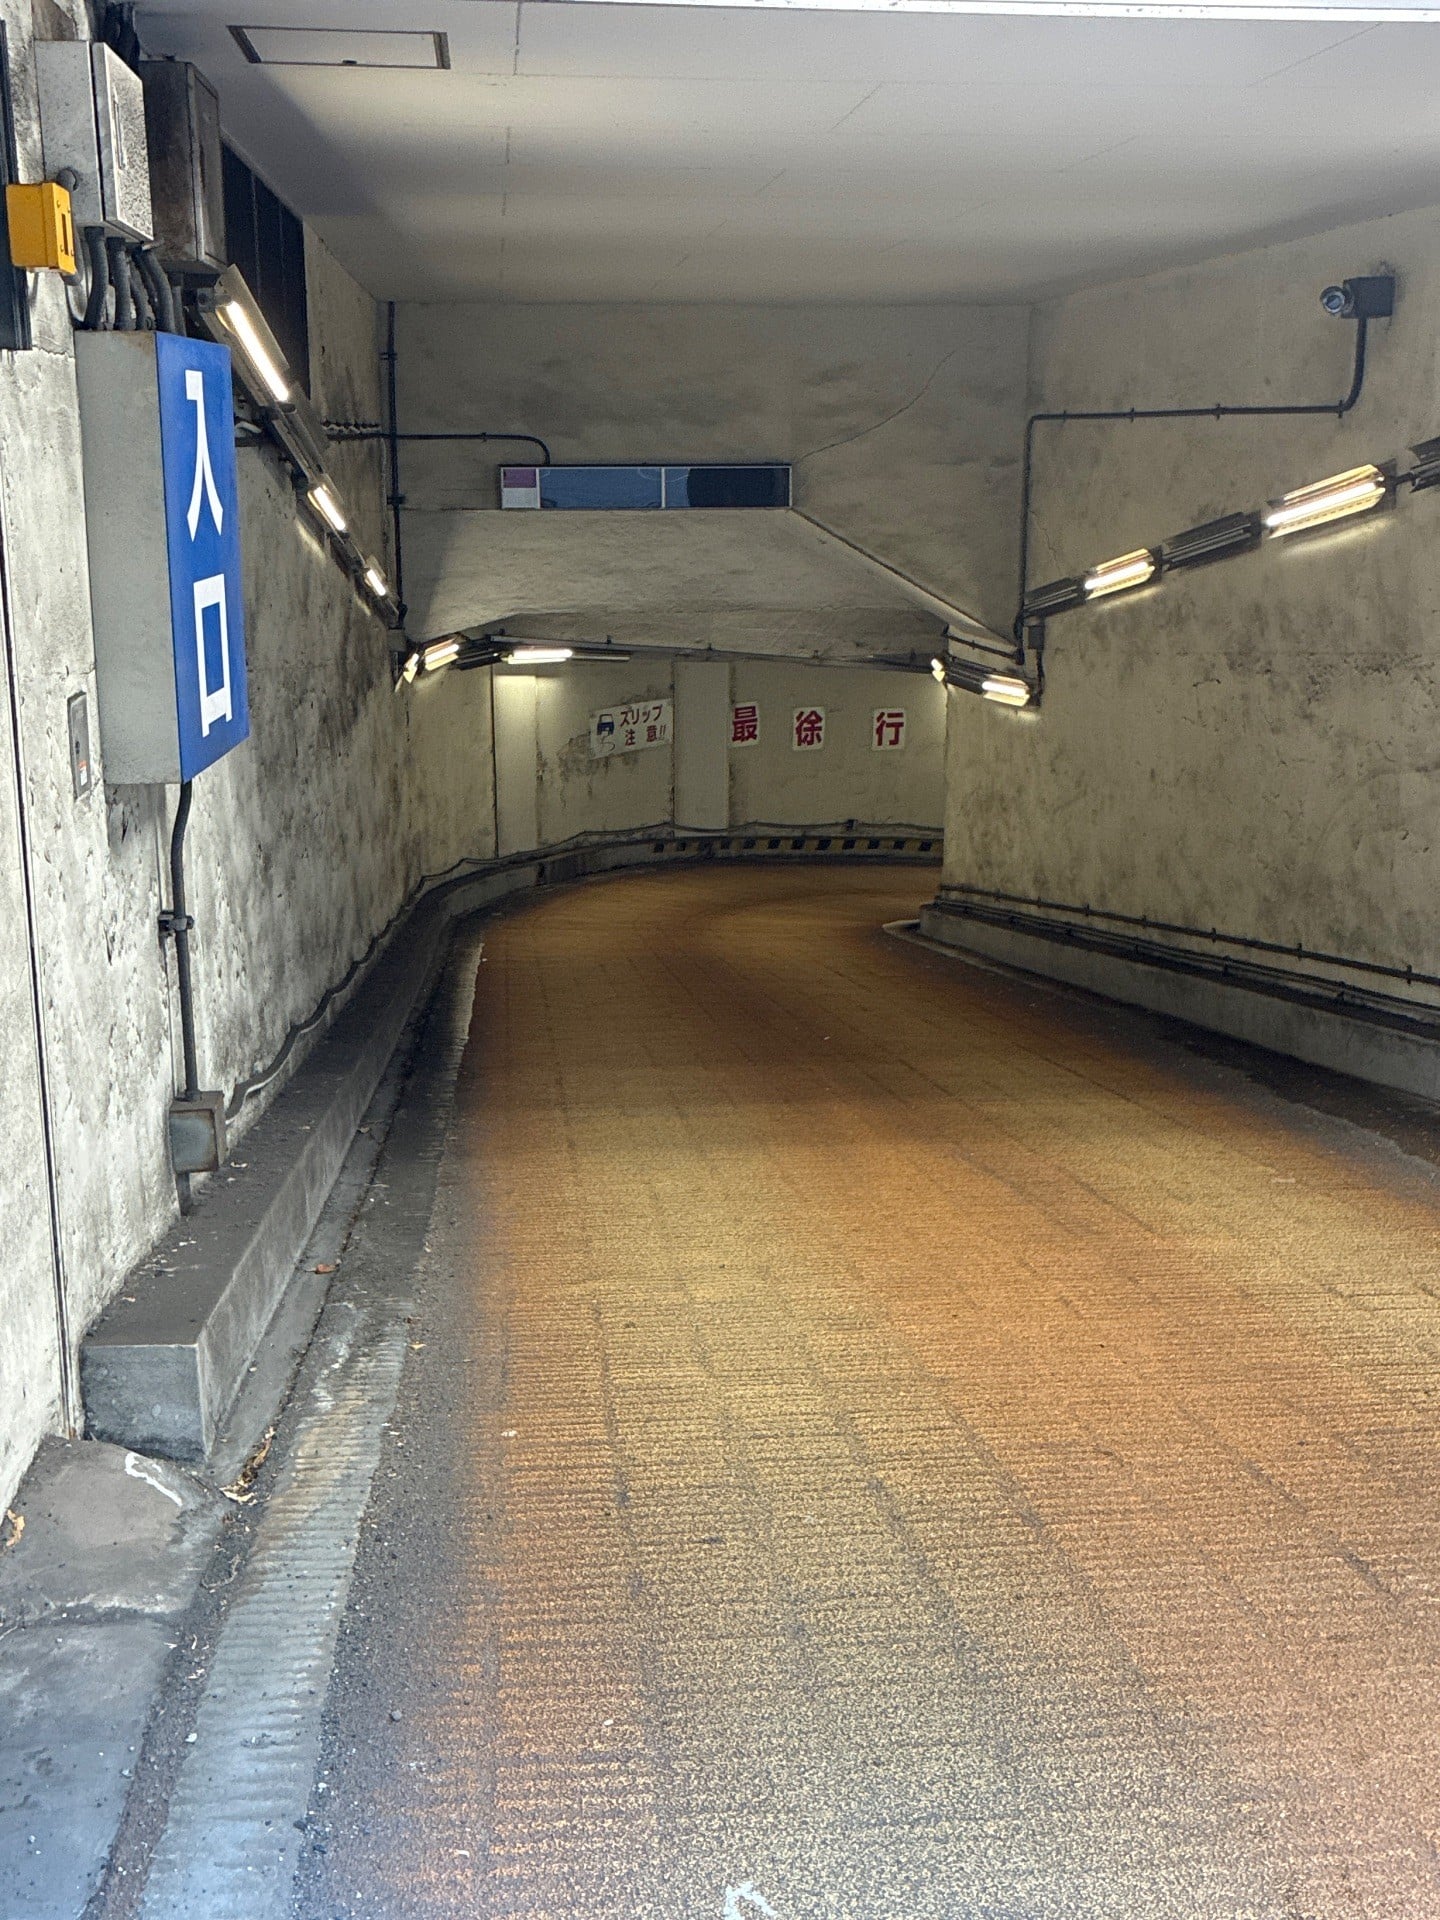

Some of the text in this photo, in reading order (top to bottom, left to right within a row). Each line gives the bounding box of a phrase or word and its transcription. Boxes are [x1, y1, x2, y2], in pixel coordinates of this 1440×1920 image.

[185, 369, 232, 738] 入口
[619, 704, 664, 728] スリップ
[732, 705, 905, 747] 最徐行
